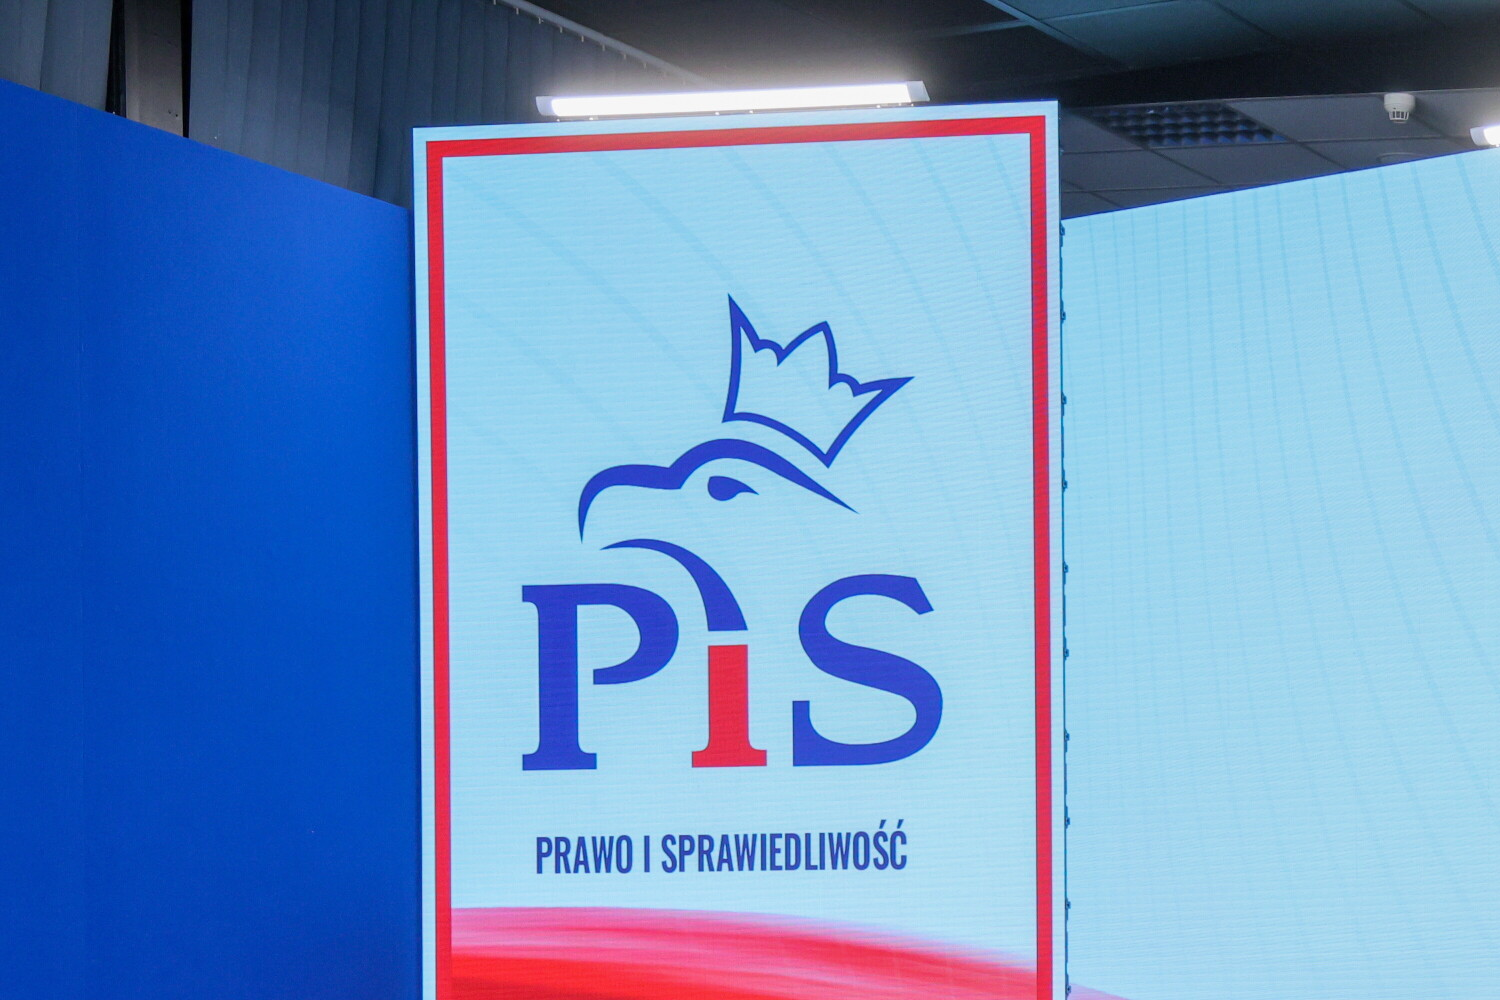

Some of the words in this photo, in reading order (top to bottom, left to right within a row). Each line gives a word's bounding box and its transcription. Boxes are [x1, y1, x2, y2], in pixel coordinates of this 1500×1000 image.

[522, 573, 943, 771] PiS
[536, 835, 633, 874] PRAWO
[644, 835, 651, 873] I
[661, 819, 907, 873] SPRAWIEDLIWOŚĆ
